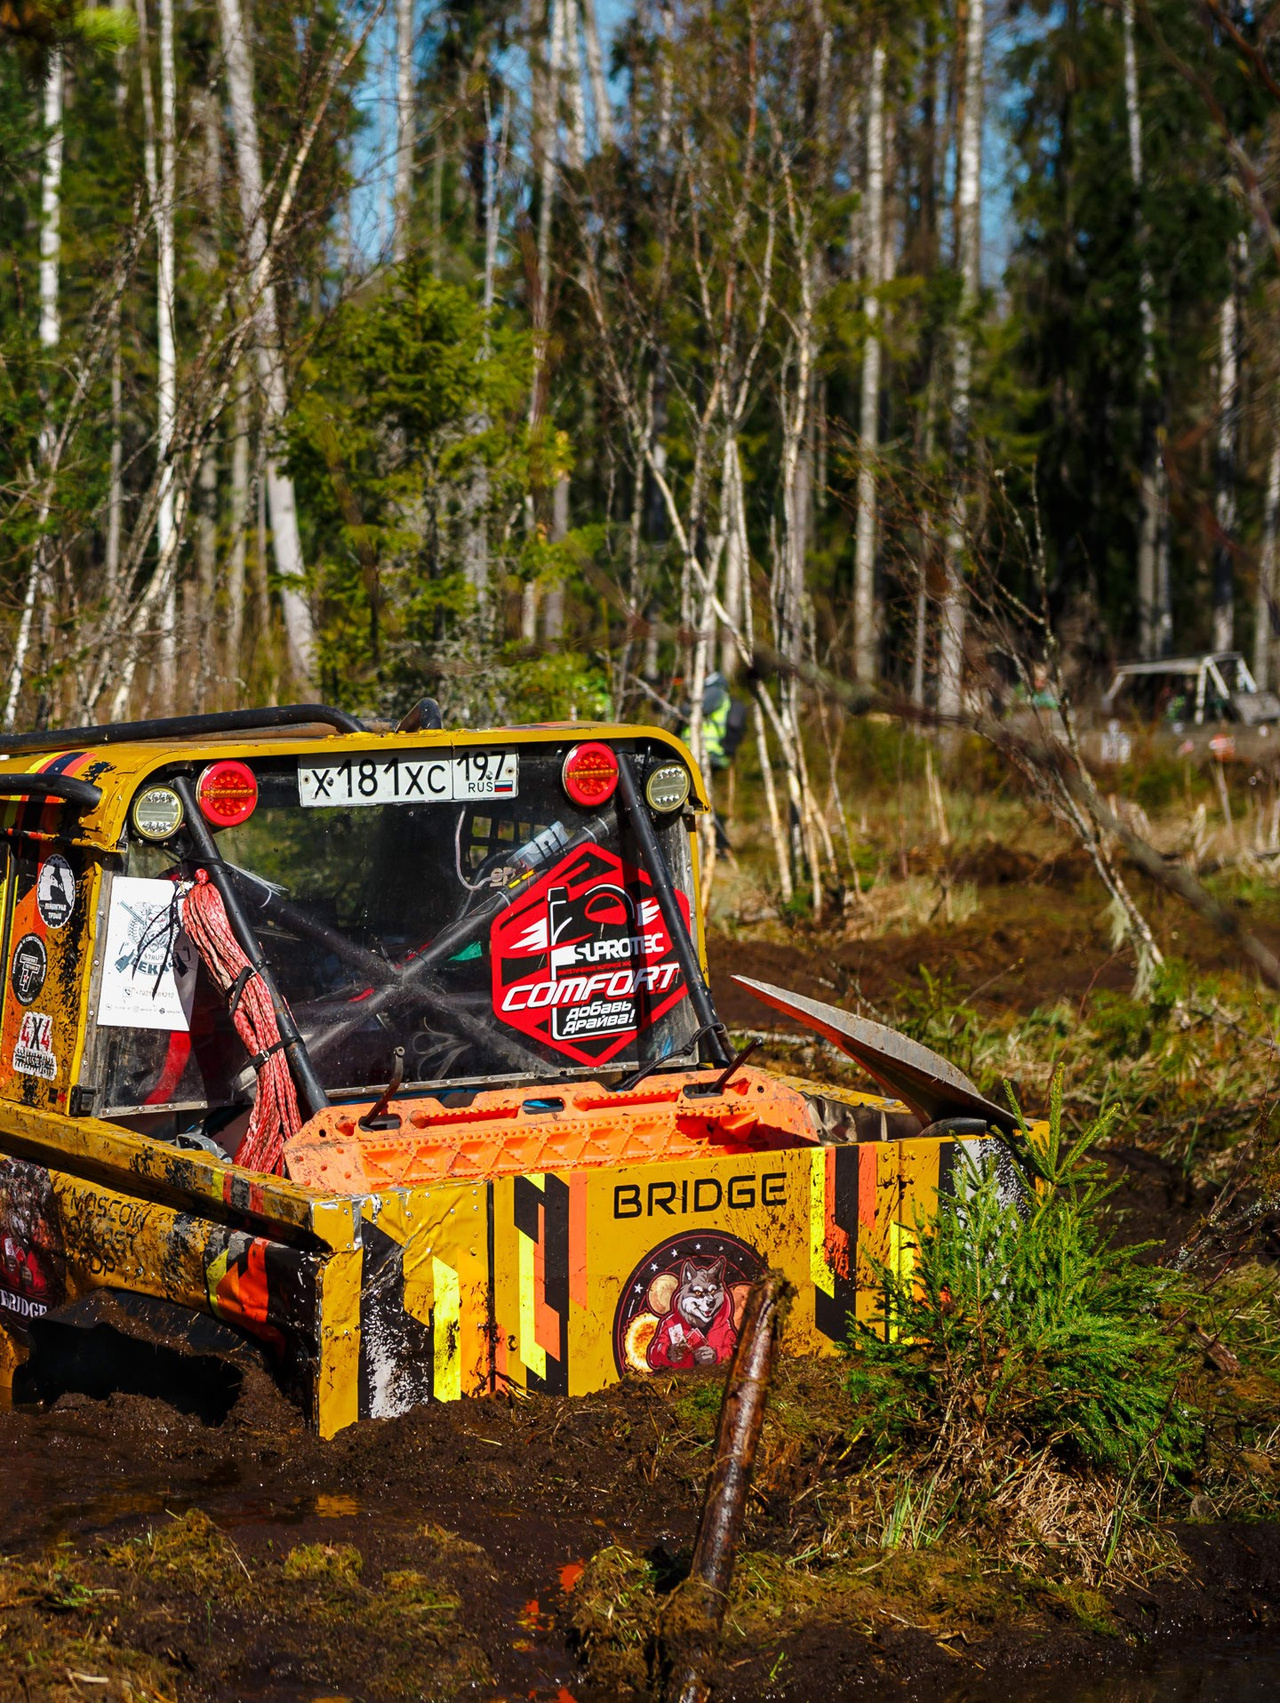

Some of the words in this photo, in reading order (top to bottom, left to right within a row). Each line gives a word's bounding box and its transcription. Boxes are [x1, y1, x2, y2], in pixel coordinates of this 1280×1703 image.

[456, 751, 506, 781] 197
[468, 781, 493, 793] RUS
[573, 932, 665, 963] SUPROTEC
[501, 962, 680, 1012] COMFORT
[613, 1172, 787, 1219] BRIDGE
[0, 1288, 48, 1318] BRIDGE
